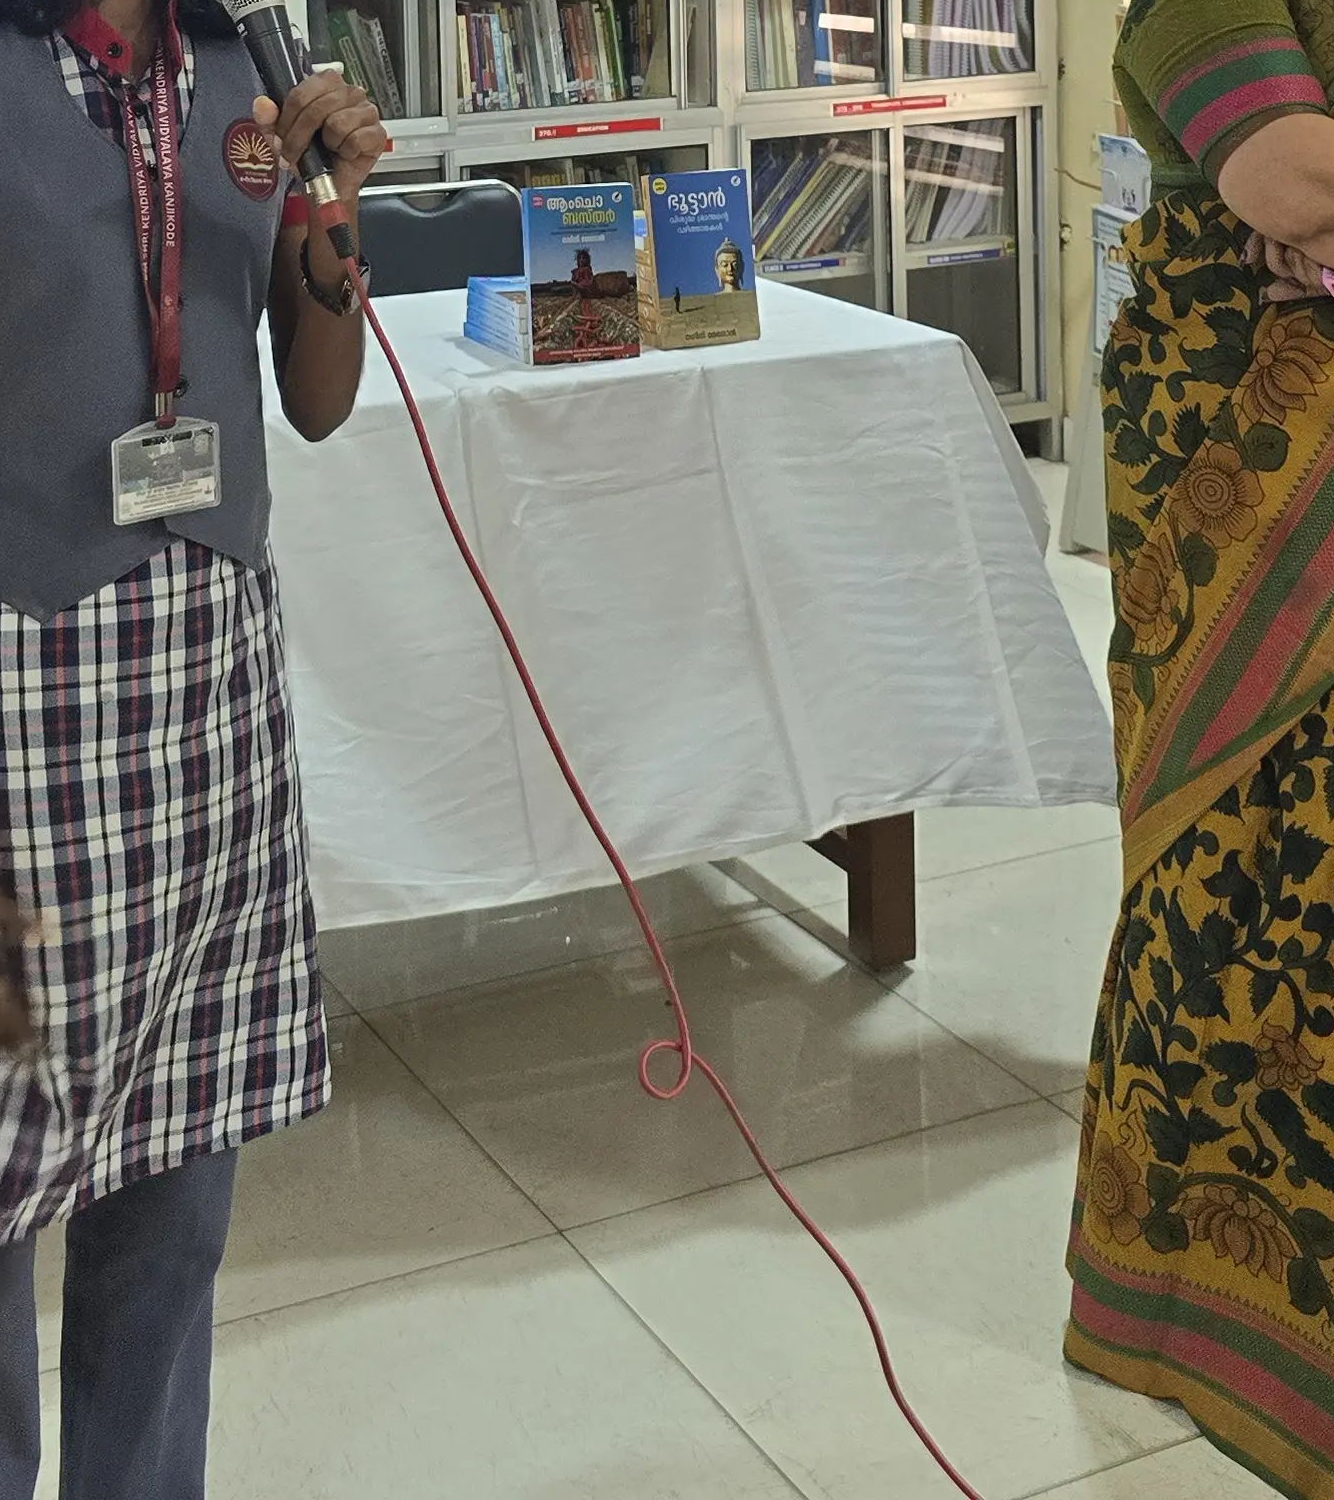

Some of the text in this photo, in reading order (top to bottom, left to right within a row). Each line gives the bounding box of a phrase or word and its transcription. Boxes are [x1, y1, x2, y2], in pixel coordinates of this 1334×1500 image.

[155, 59, 176, 248] KENDRIYA VIDYALAYA KANJIKODE
[135, 169, 150, 229] KENDRIYA
[562, 208, 616, 225] ബസ്തർ
[668, 186, 726, 215] ഭൂട്ടാൻ
